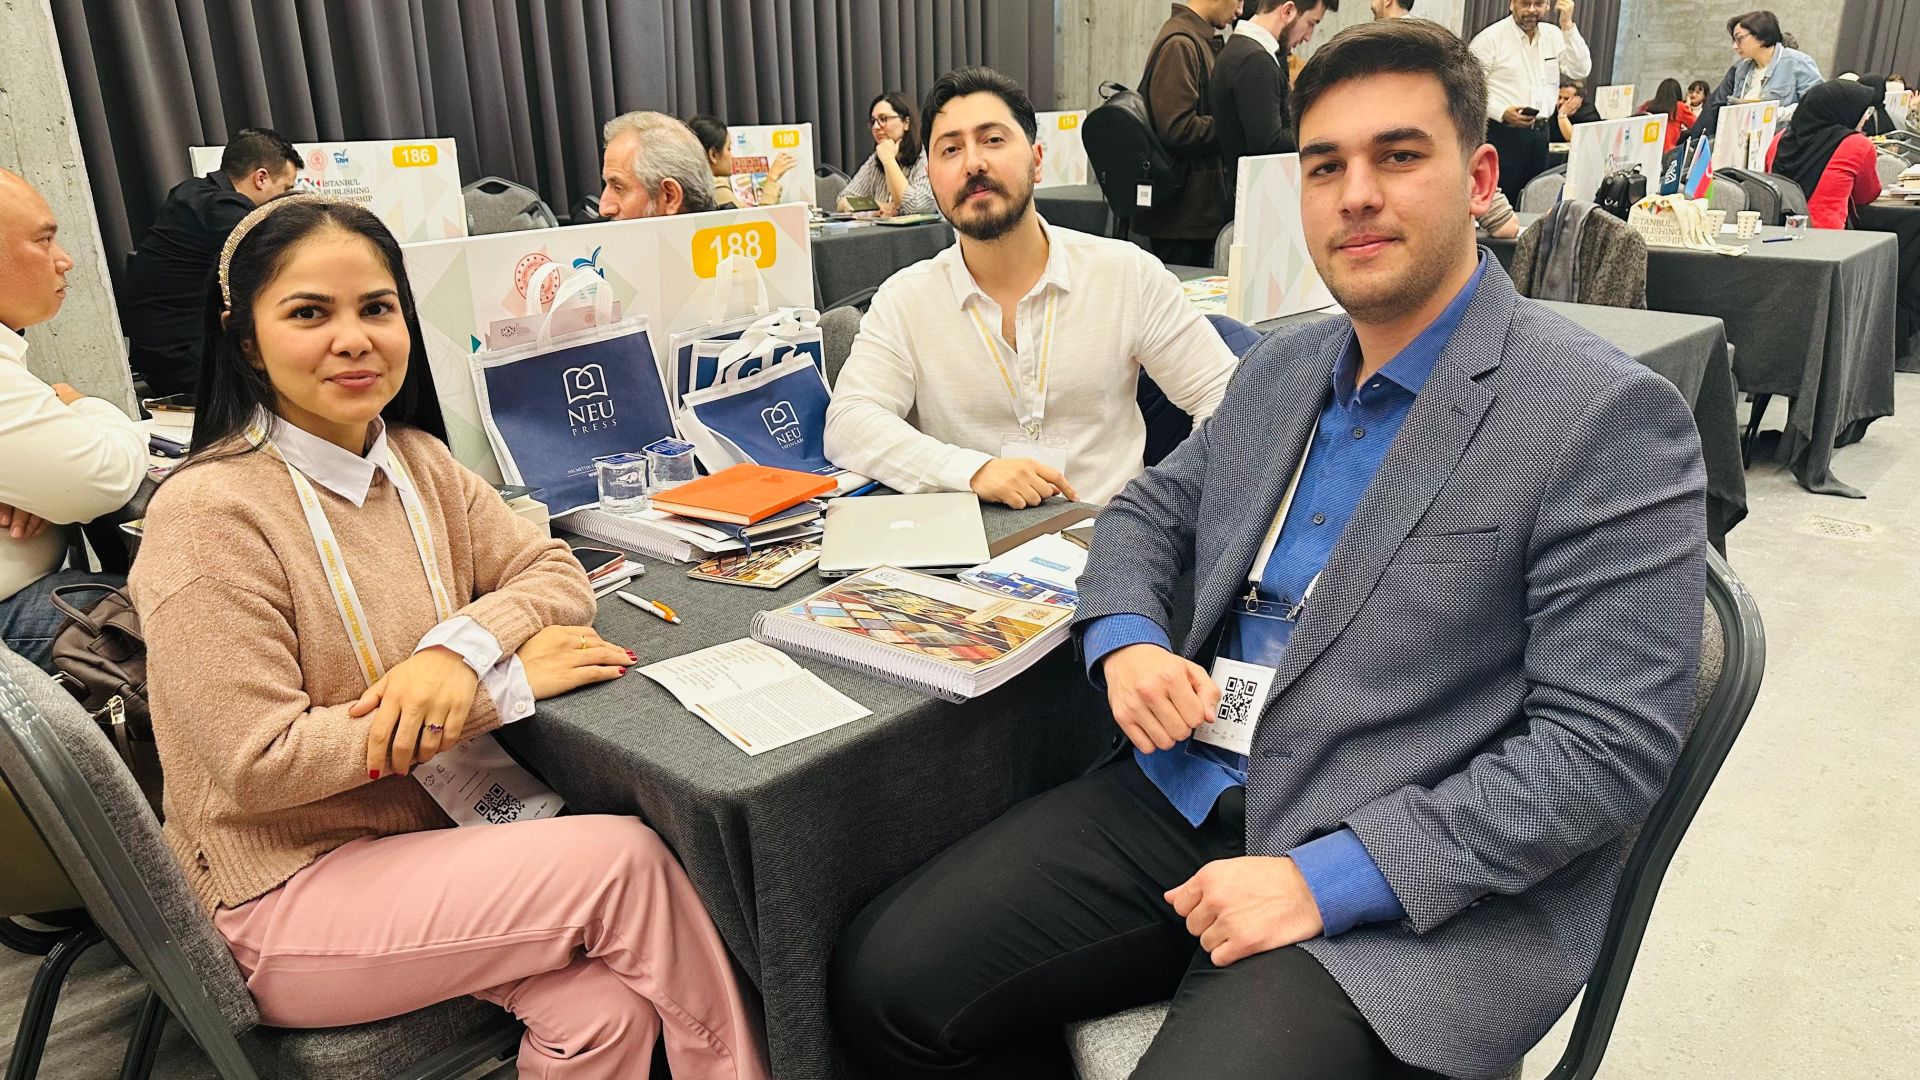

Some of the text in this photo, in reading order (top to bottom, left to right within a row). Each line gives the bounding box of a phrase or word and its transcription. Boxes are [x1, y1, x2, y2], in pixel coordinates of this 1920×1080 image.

[401, 148, 430, 163] 186
[322, 179, 361, 187] ISTANBUL
[323, 186, 370, 196] PUBLISHING
[709, 229, 762, 264] 188
[567, 399, 615, 427] NEU
[571, 418, 617, 437] PRESS
[321, 538, 347, 593] FELLOWSHIP
[340, 590, 364, 642] PUBLISHING
